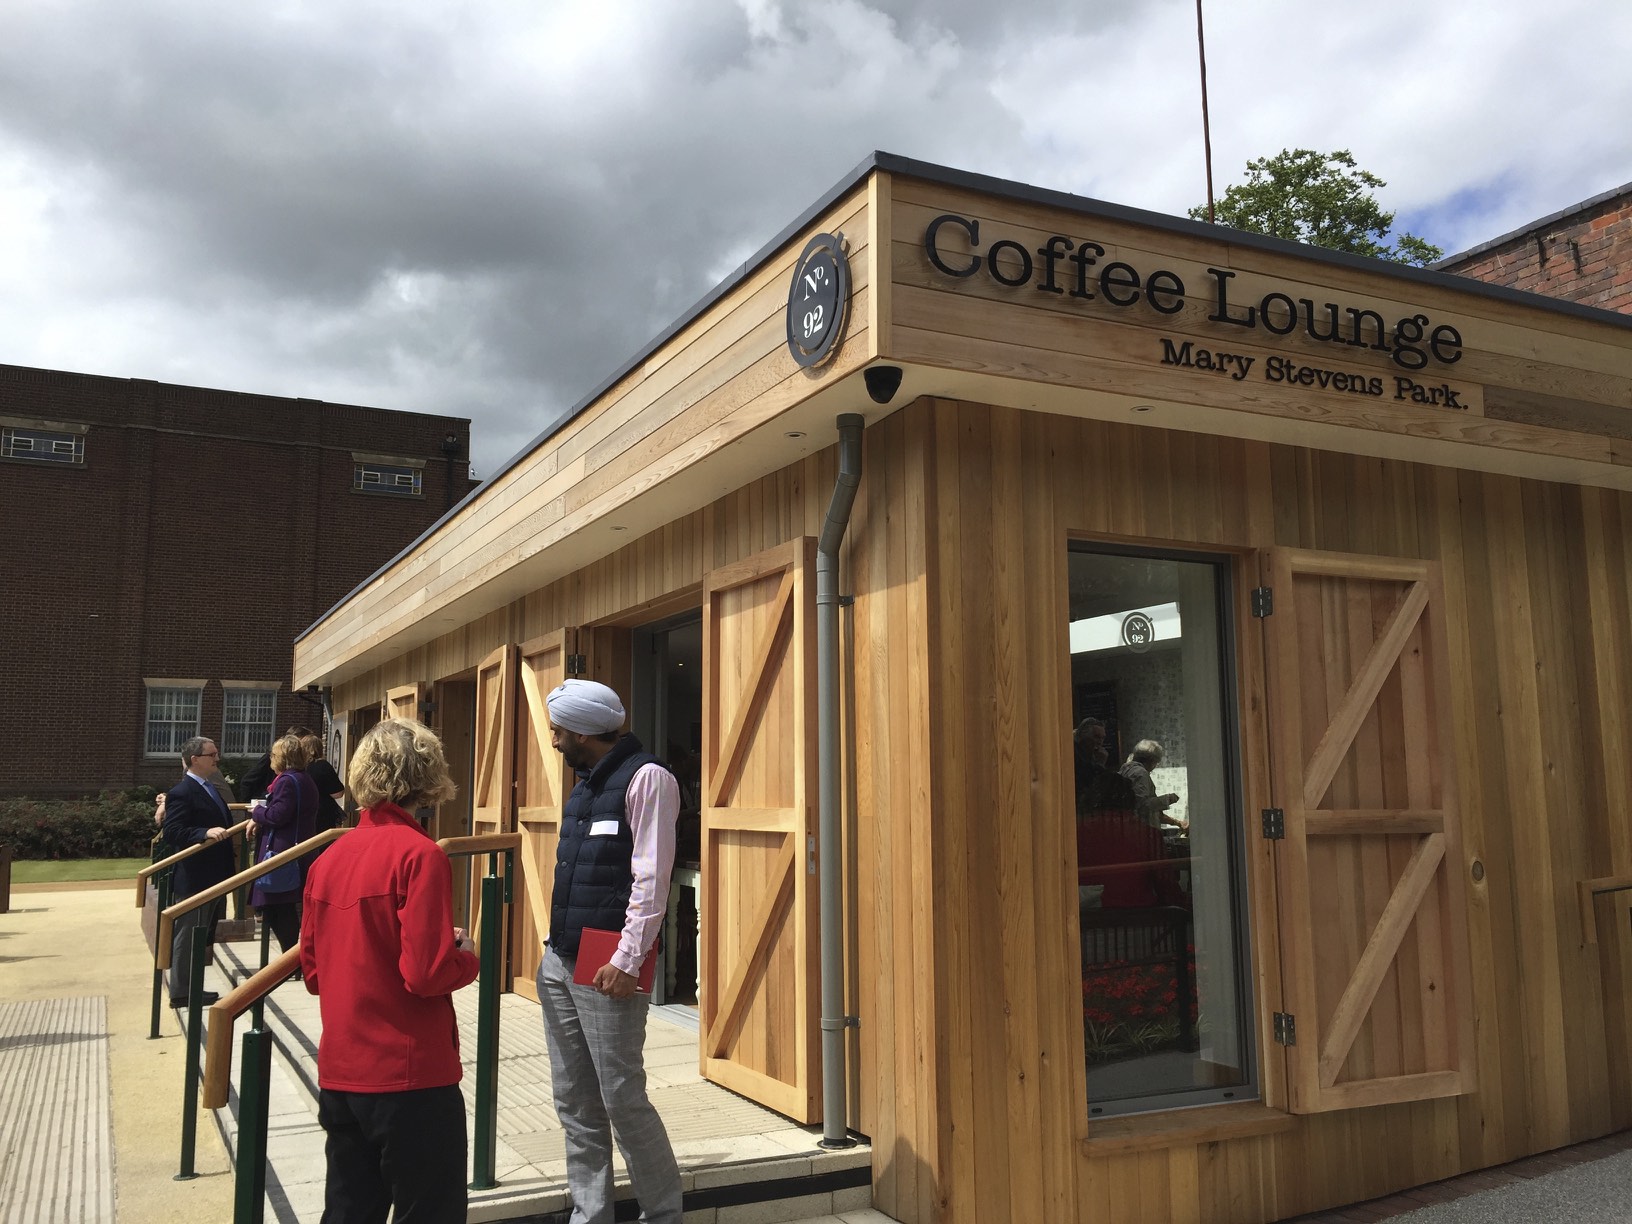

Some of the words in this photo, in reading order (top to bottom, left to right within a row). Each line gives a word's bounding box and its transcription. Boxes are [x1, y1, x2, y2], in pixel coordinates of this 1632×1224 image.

[925, 214, 1185, 315] Coffee
[1207, 268, 1462, 369] Lounge
[803, 304, 823, 338] 92
[1160, 338, 1255, 381] Mary
[1265, 356, 1383, 396] Stevens
[1393, 376, 1469, 410] Park.
[1131, 633, 1144, 644] 92
